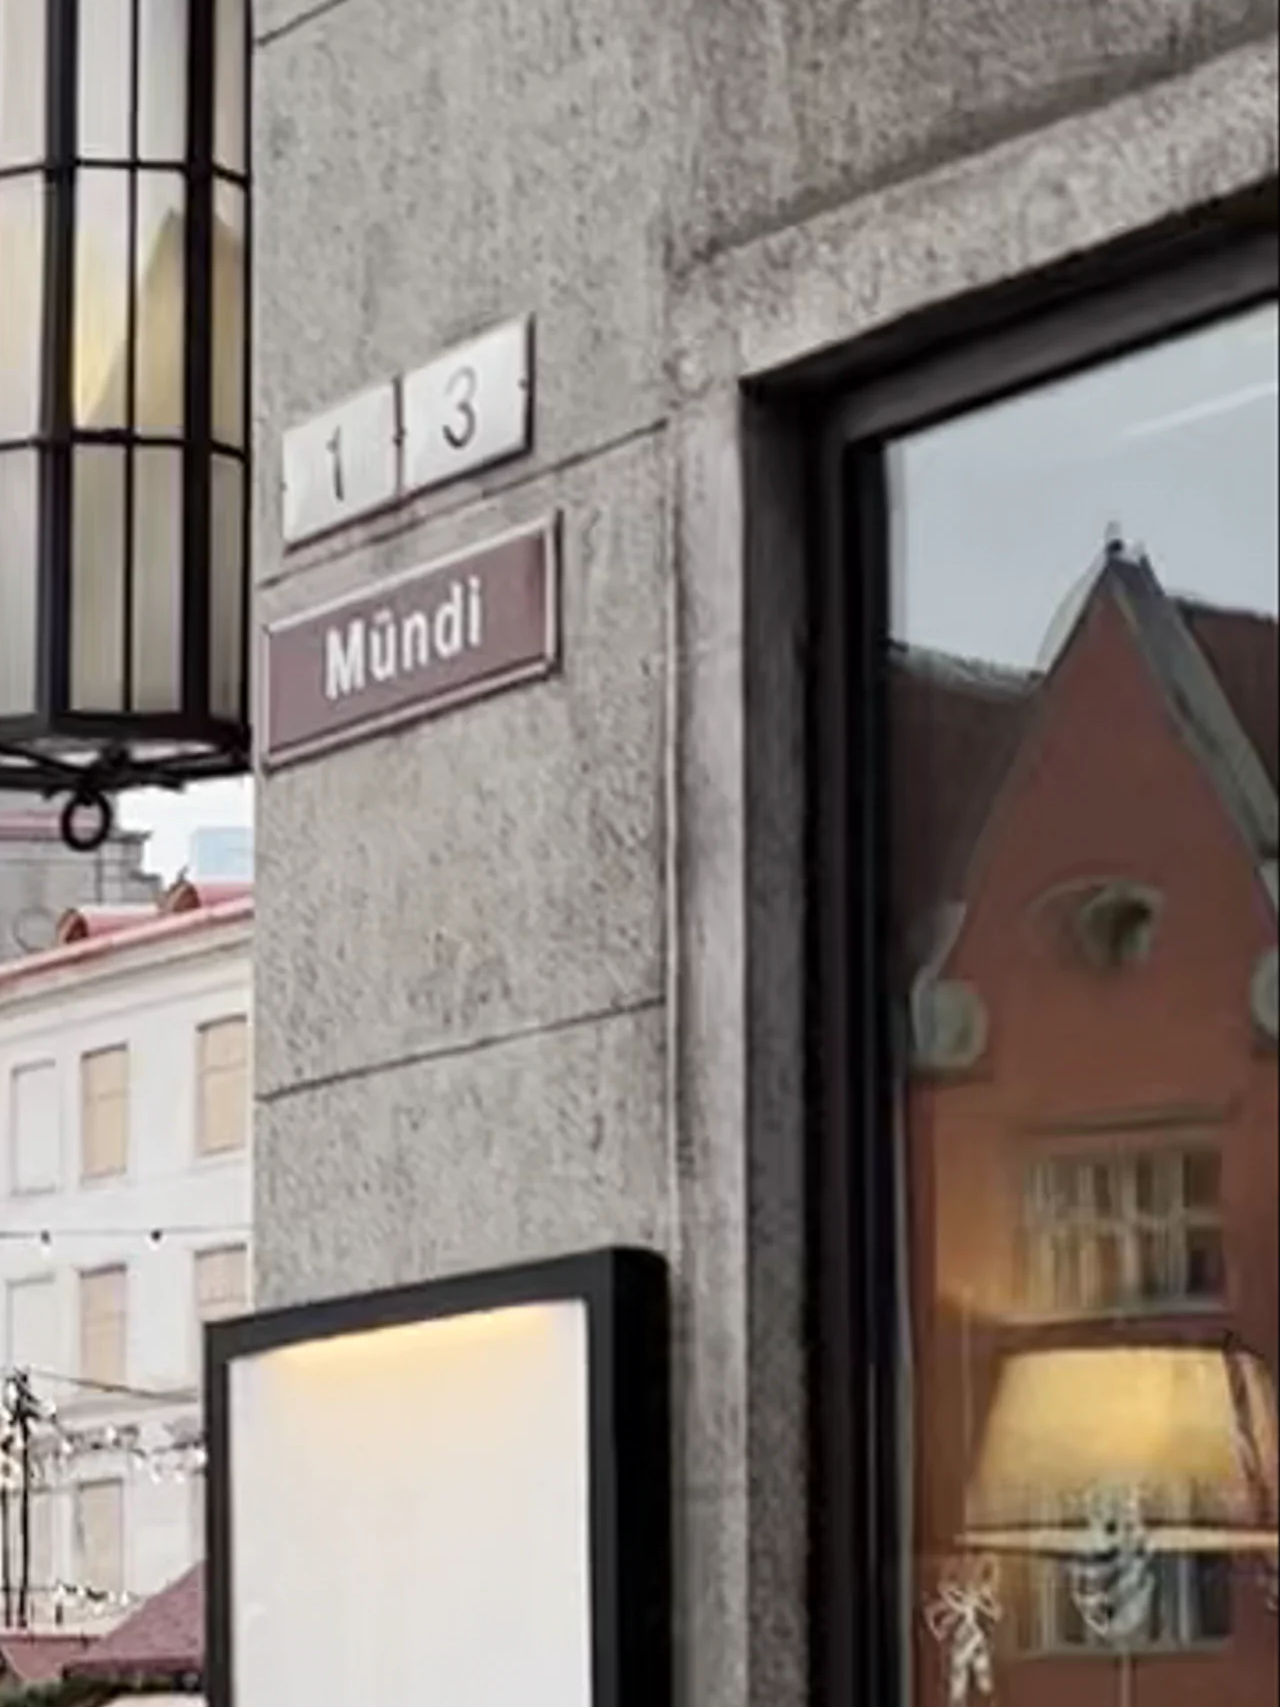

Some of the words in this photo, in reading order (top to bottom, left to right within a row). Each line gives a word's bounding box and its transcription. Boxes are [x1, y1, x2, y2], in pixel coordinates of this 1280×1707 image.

[325, 423, 345, 502] 1
[442, 365, 478, 451] 3
[324, 576, 483, 702] Mündi
